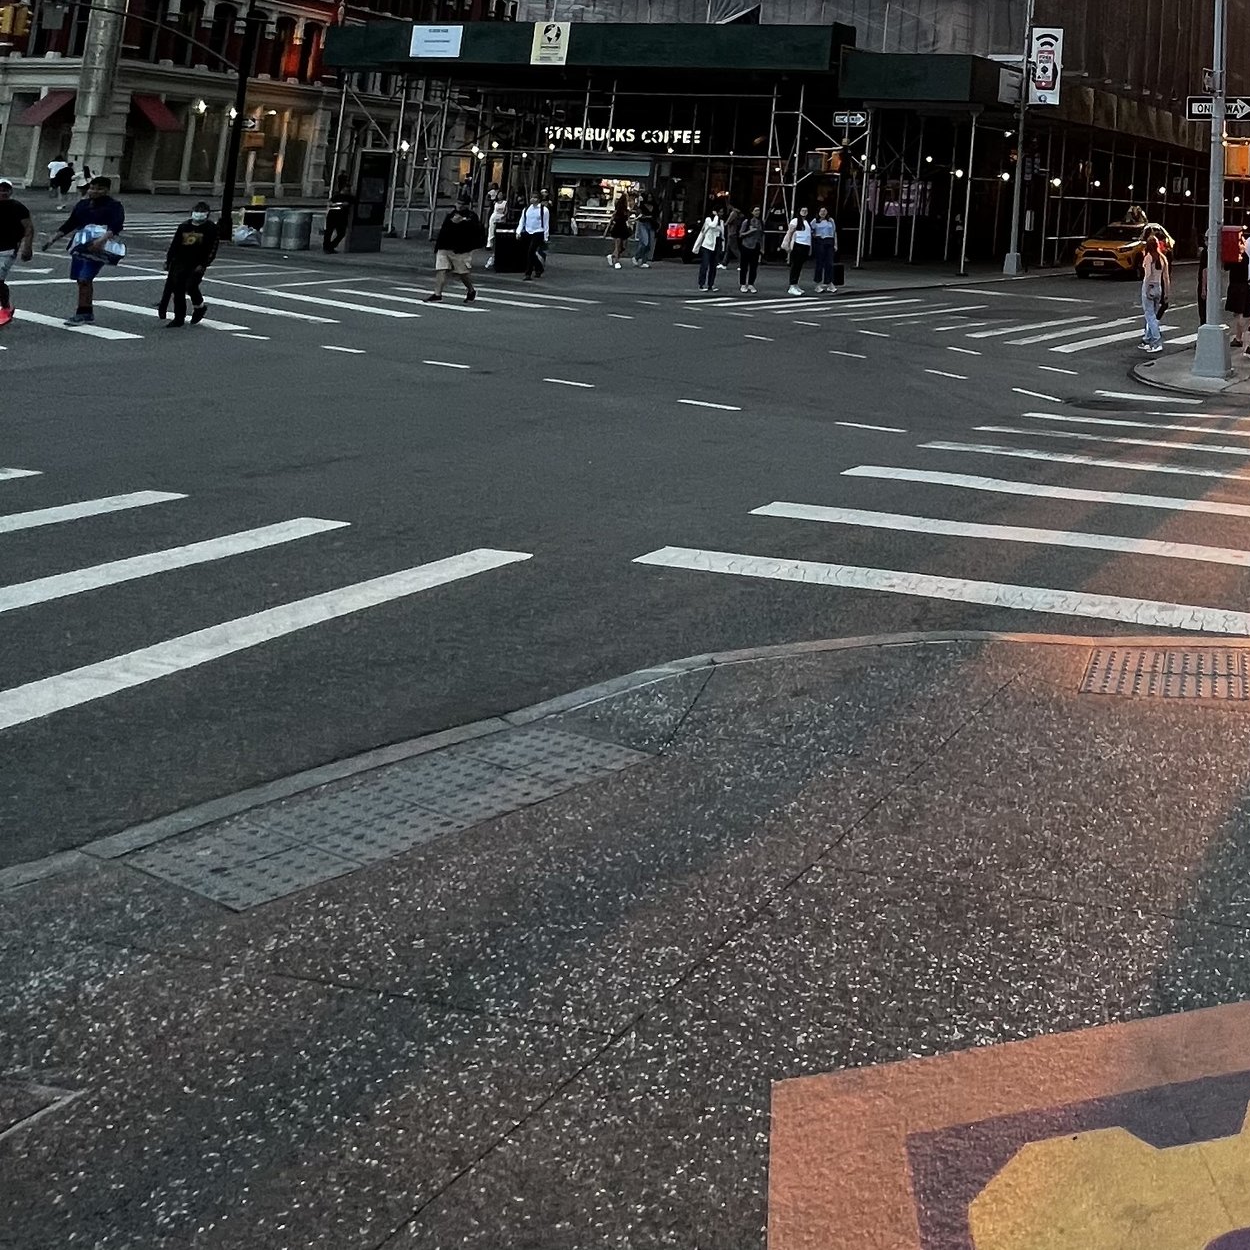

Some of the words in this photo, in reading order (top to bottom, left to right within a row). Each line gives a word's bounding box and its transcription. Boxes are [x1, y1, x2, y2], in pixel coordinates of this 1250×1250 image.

[1225, 103, 1246, 114] WAY
[544, 125, 636, 142] STARBUCKS
[641, 129, 702, 144] COFFEE
